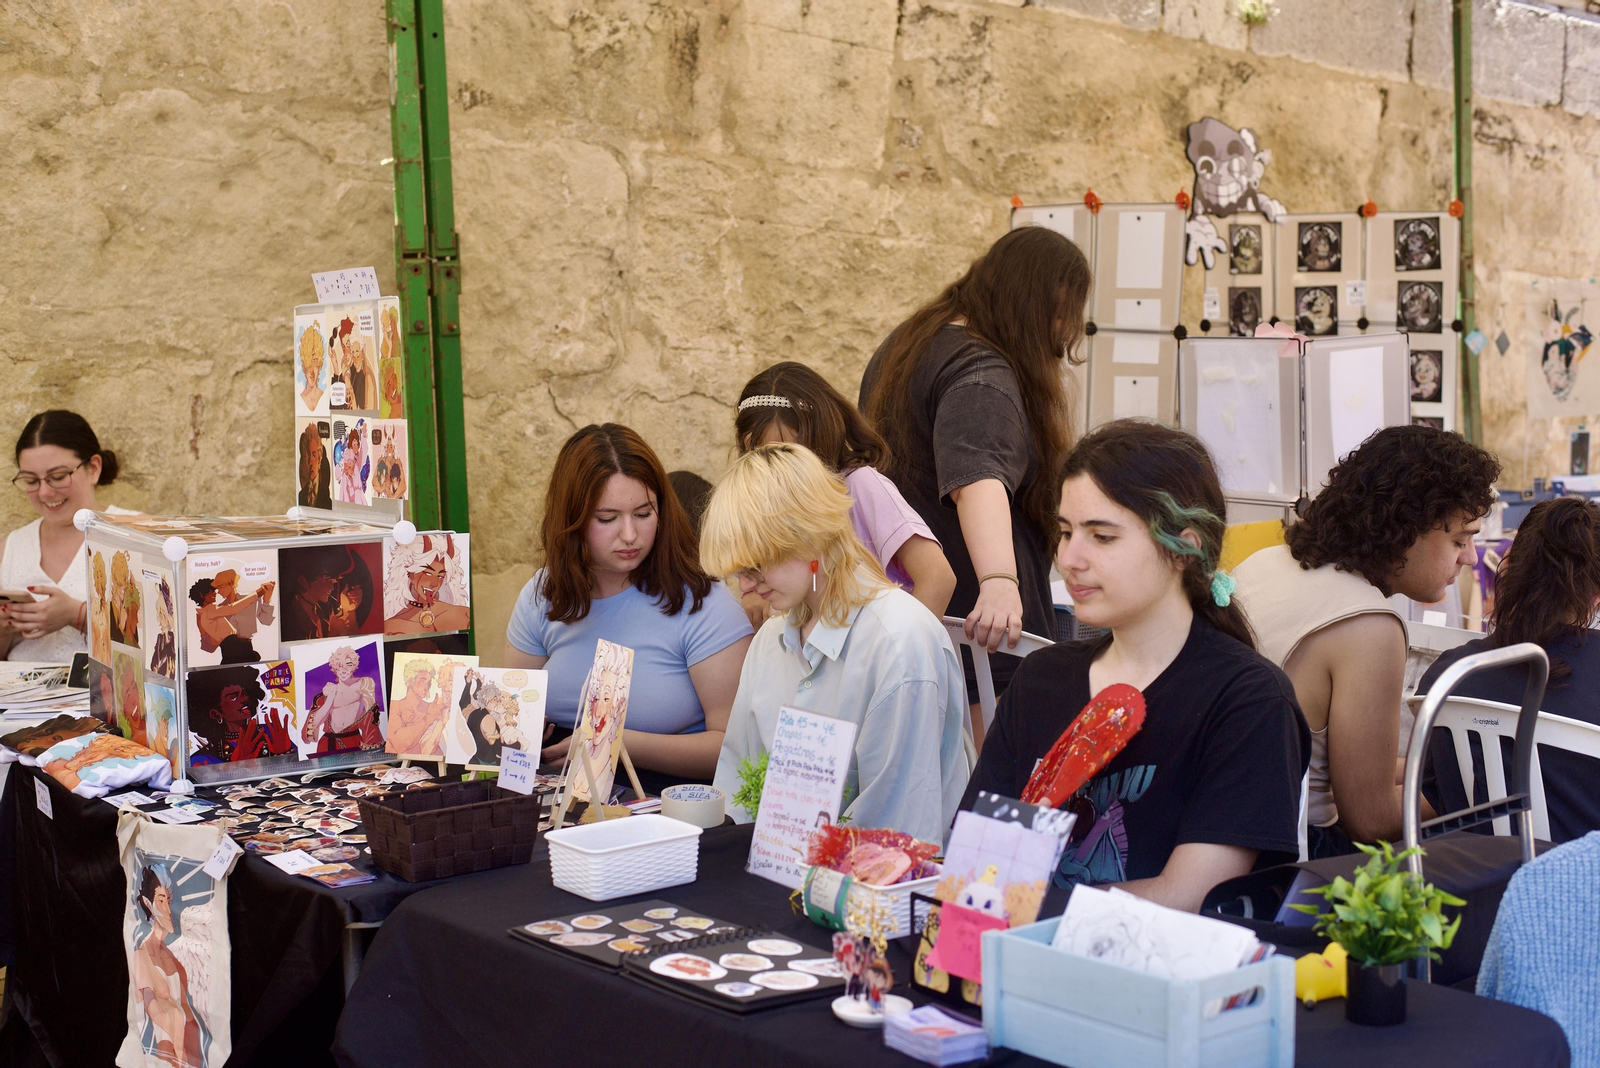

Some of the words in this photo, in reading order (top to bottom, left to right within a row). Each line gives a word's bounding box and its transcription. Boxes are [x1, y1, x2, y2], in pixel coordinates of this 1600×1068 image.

[778, 726, 802, 740] Chapas
[817, 735, 828, 748] 1€
[822, 721, 836, 736] 4€
[774, 739, 816, 762] Pegatinas
